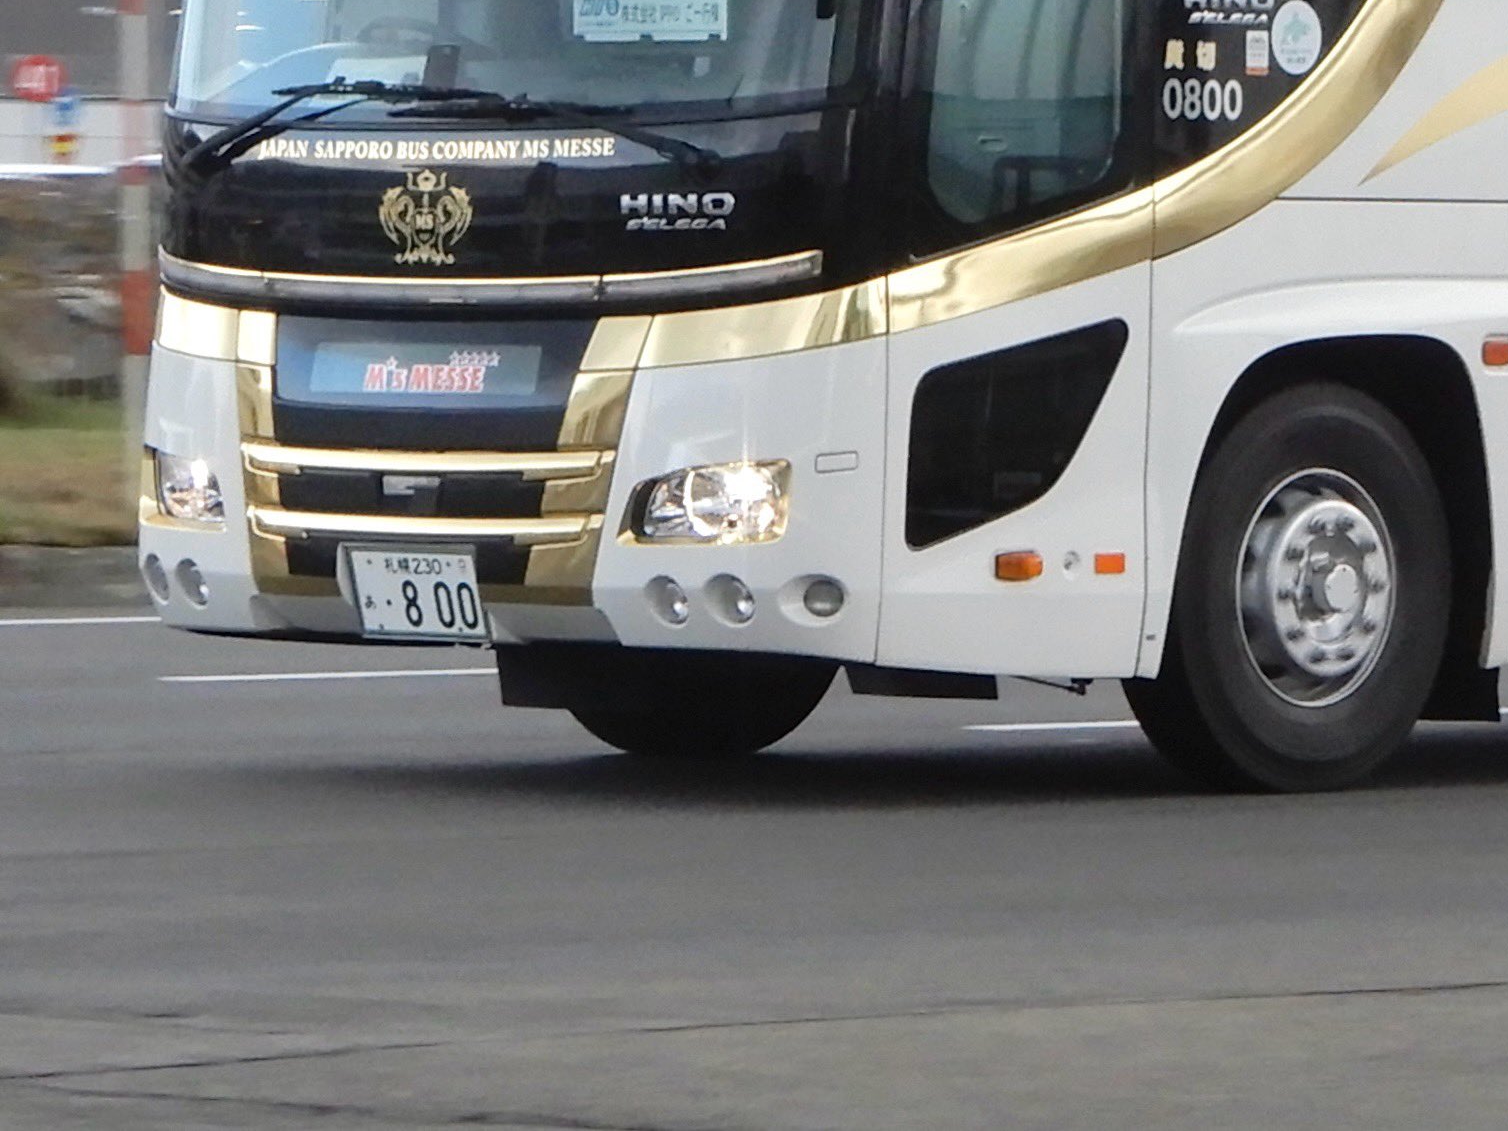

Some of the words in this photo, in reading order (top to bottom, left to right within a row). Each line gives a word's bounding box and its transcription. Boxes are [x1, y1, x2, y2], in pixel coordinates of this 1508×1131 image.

[1162, 77, 1243, 121] 0800
[257, 138, 310, 161] JAPAN
[314, 139, 394, 160] SAPPORO
[396, 139, 430, 159] BUS
[432, 139, 519, 159] COMPANY
[522, 138, 550, 158] MS
[552, 136, 615, 158] MESSE
[620, 191, 736, 216] HINO
[408, 364, 486, 393] MESSE
